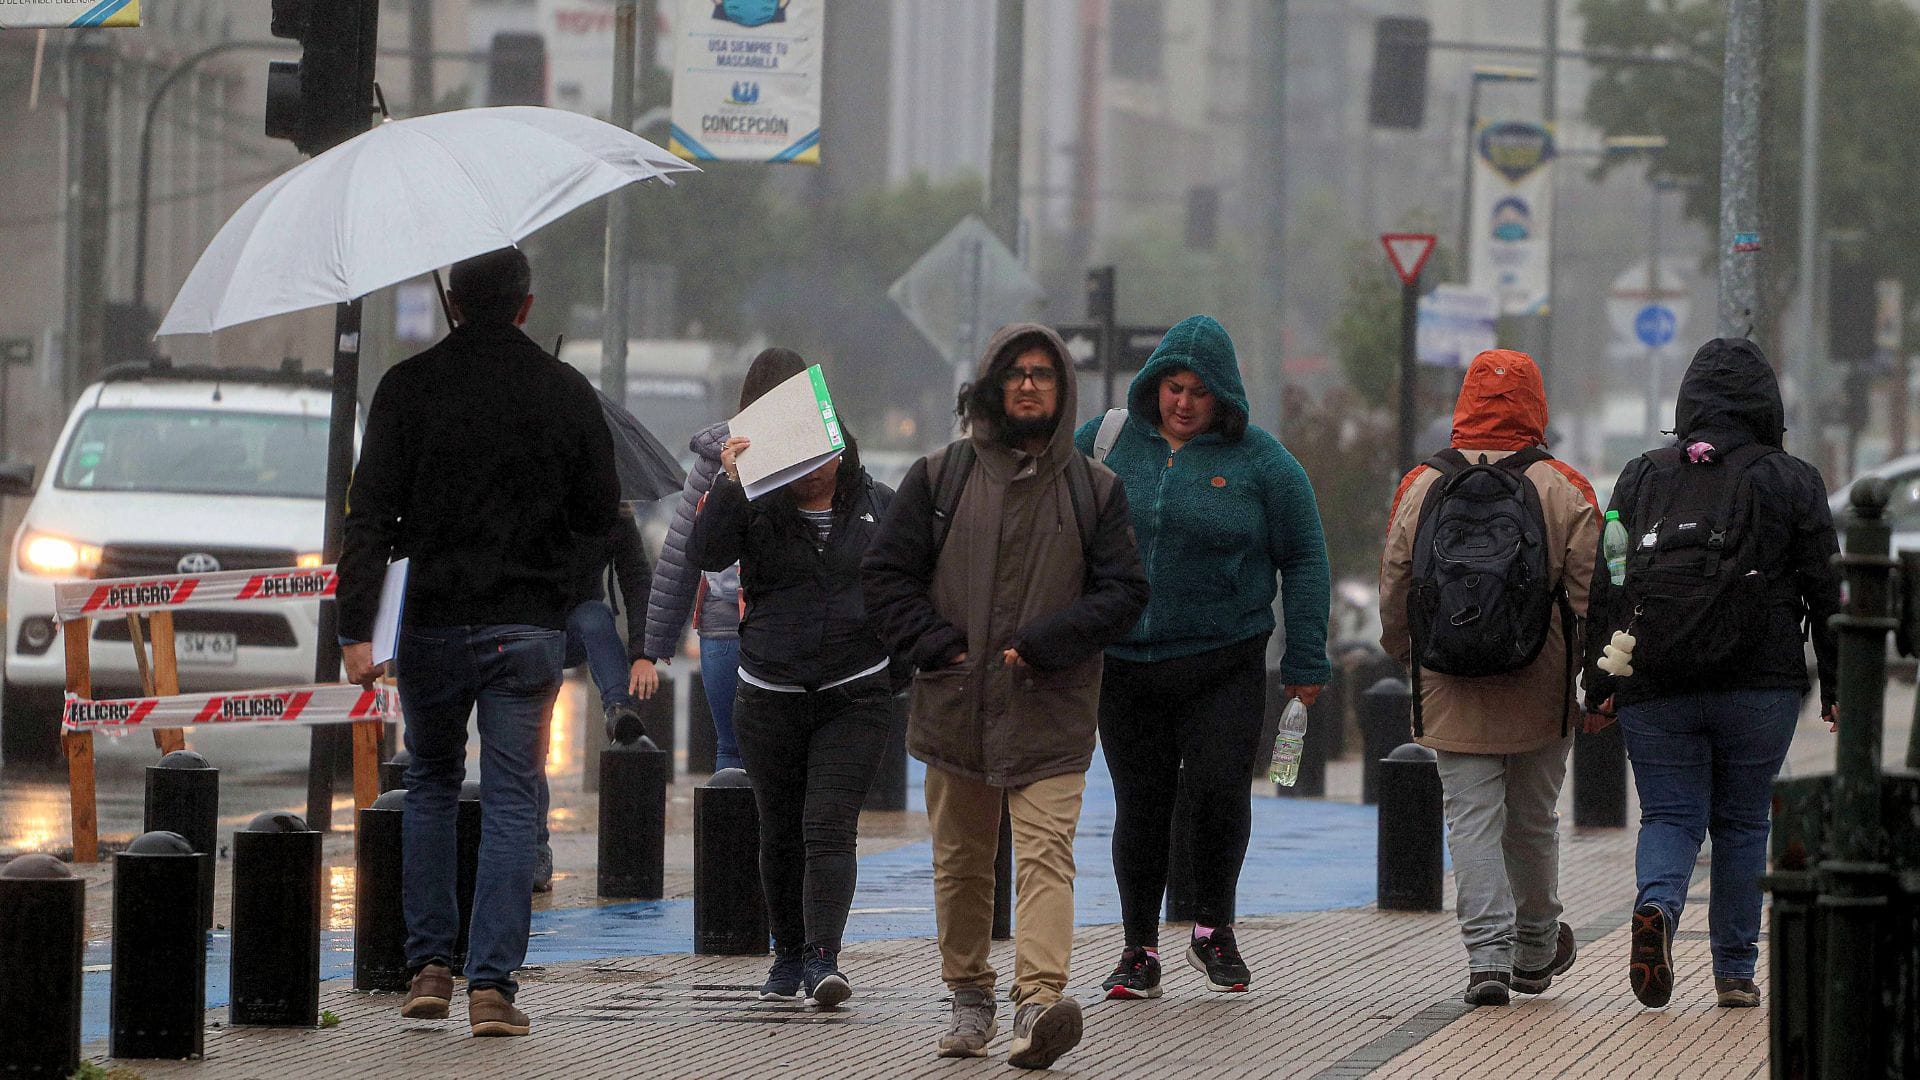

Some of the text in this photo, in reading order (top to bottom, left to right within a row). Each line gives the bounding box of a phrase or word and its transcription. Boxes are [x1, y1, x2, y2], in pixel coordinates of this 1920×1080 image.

[708, 39, 788, 55] USA SIEMPRE TU
[717, 54, 778, 68] MASCARILLA
[702, 113, 788, 133] CONCEPCIÓN
[264, 574, 325, 596] PELIGRO
[110, 586, 171, 605] PELIGRO
[223, 697, 284, 717] PELIGRO
